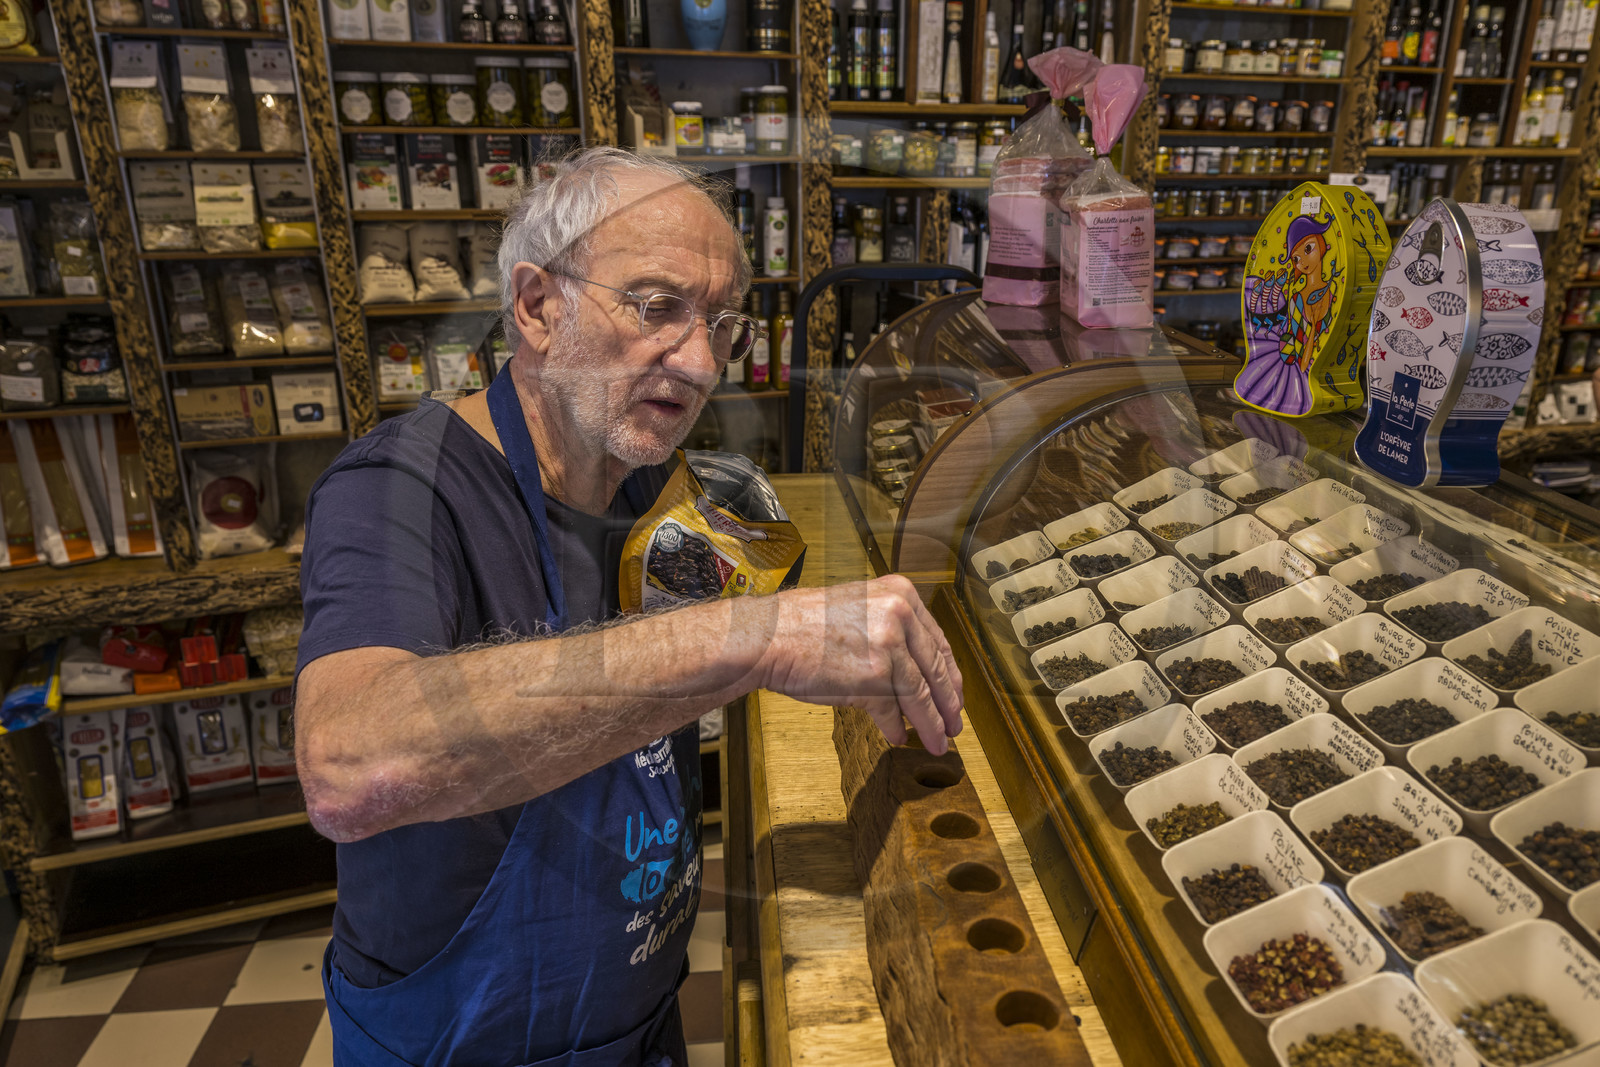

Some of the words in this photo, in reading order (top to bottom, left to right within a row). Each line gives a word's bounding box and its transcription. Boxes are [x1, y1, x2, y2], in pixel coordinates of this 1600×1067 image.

[661, 531, 679, 543] 1300
[624, 811, 678, 862] Une
[625, 910, 654, 933] des
